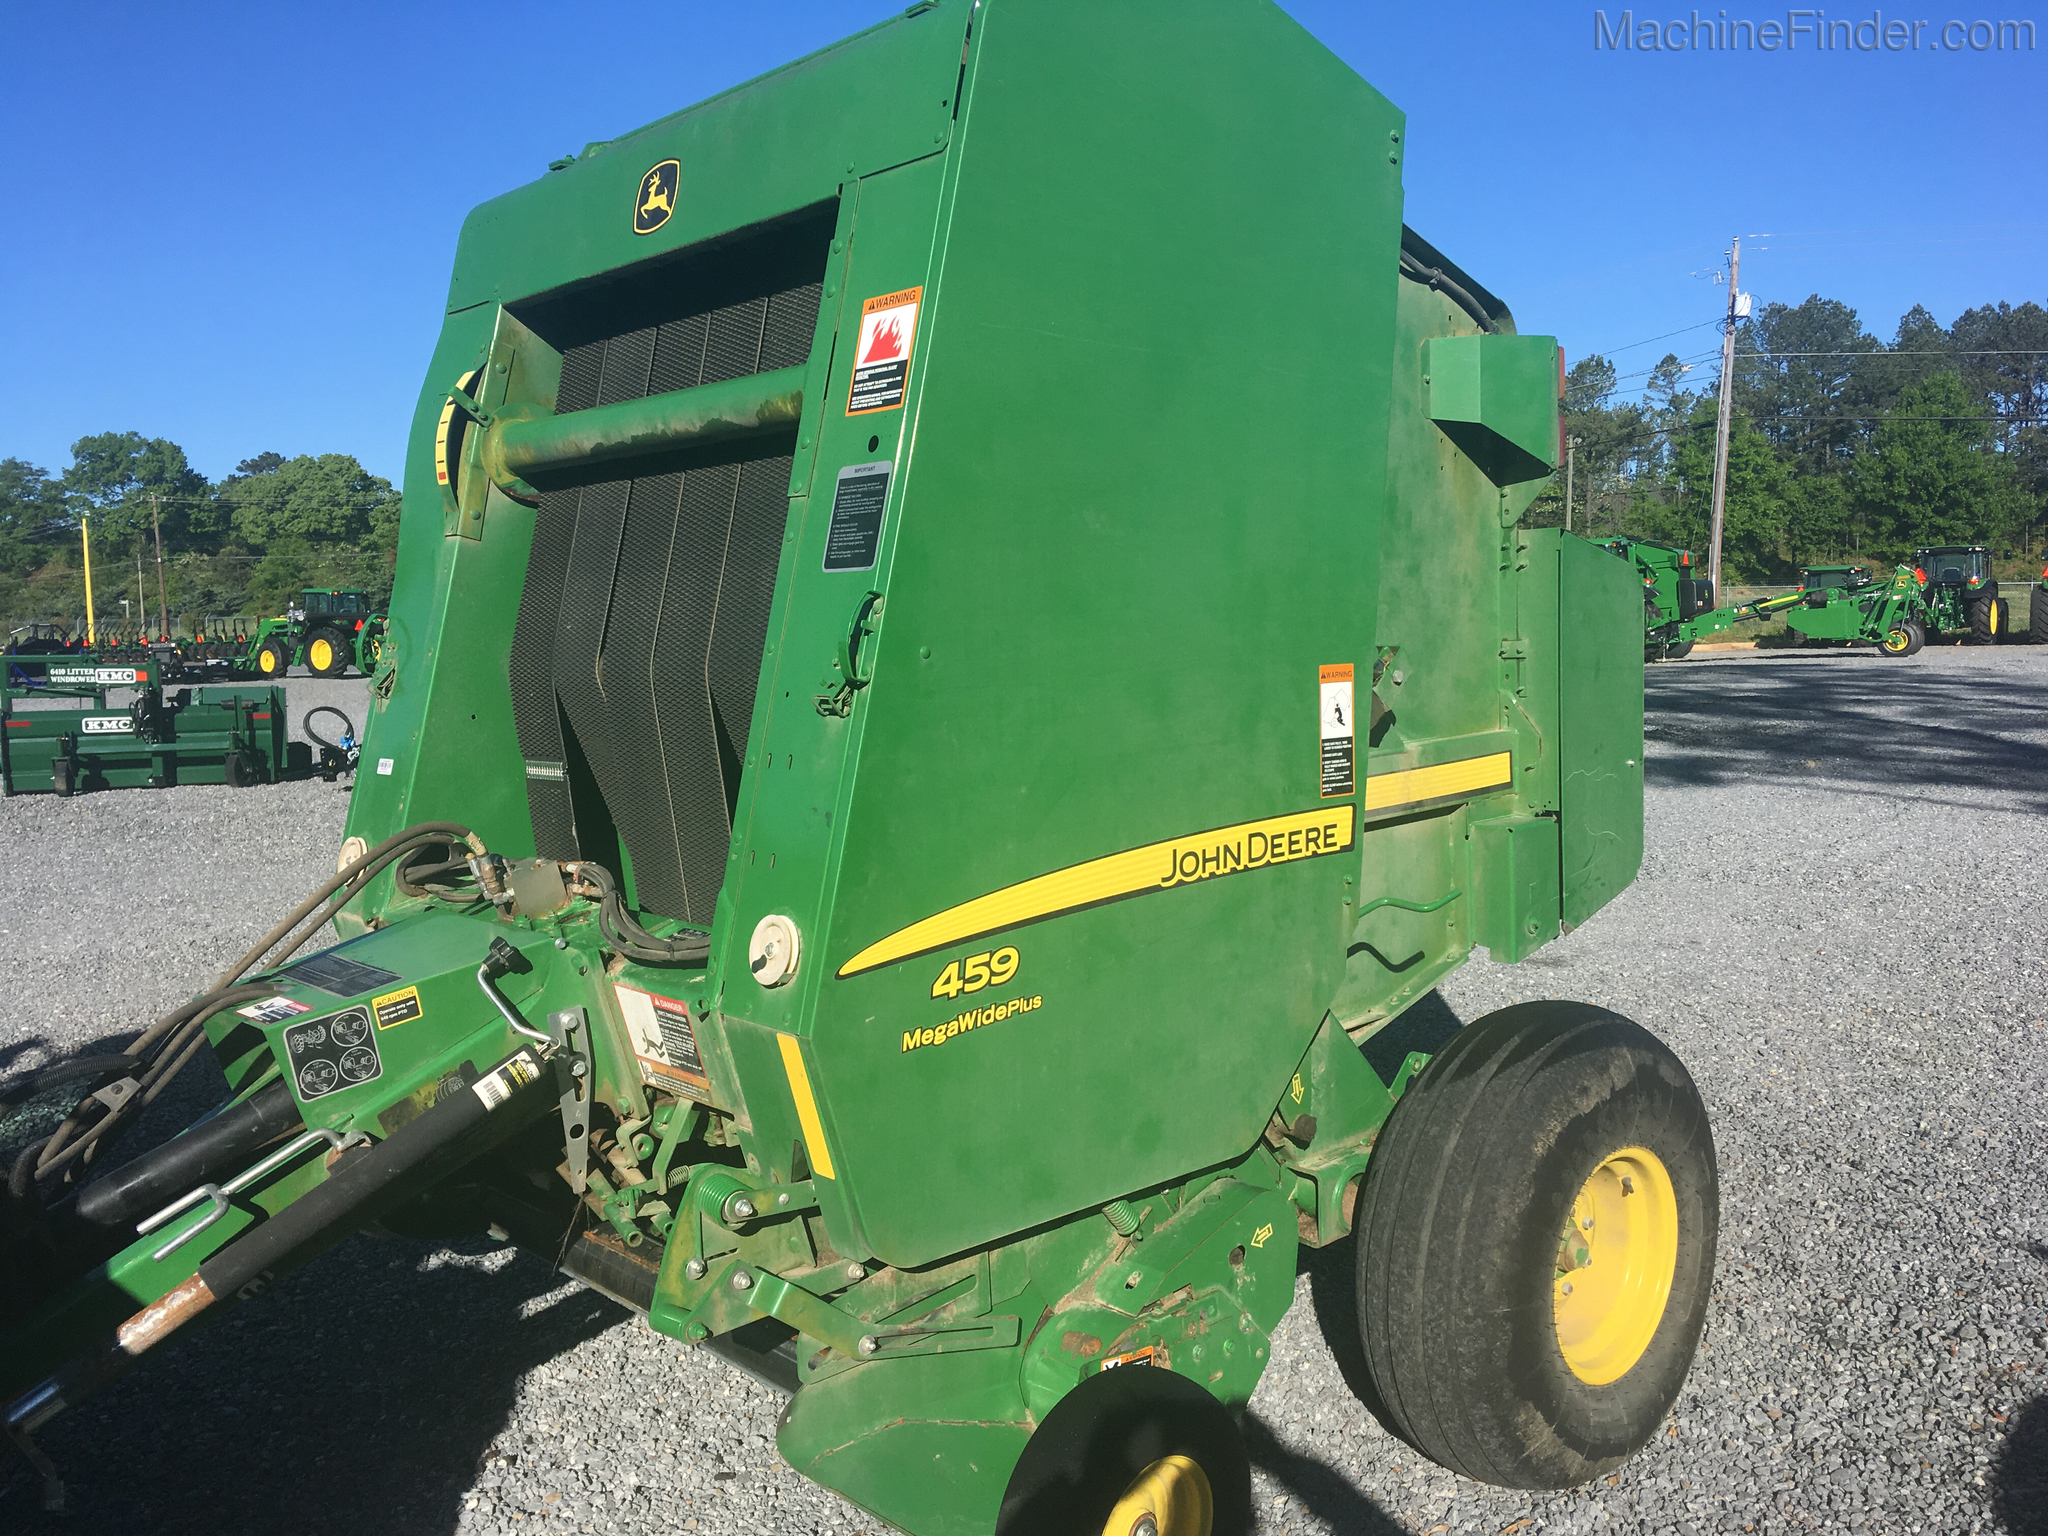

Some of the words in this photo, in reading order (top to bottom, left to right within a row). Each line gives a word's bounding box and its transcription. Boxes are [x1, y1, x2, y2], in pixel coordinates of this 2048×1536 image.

[876, 289, 917, 309] WARNING
[50, 675, 96, 683] WINDROWER
[98, 671, 132, 680] KMC
[1325, 670, 1352, 678] WARNING
[86, 720, 130, 730] KMC
[1160, 842, 1241, 883] JOHN
[1247, 823, 1338, 864] DEERE
[931, 945, 1021, 1000] 459
[382, 990, 414, 1005] CAUTION
[396, 1003, 406, 1011] only
[659, 999, 684, 1013] DANGER
[901, 995, 1044, 1054] MegaWidePlus
